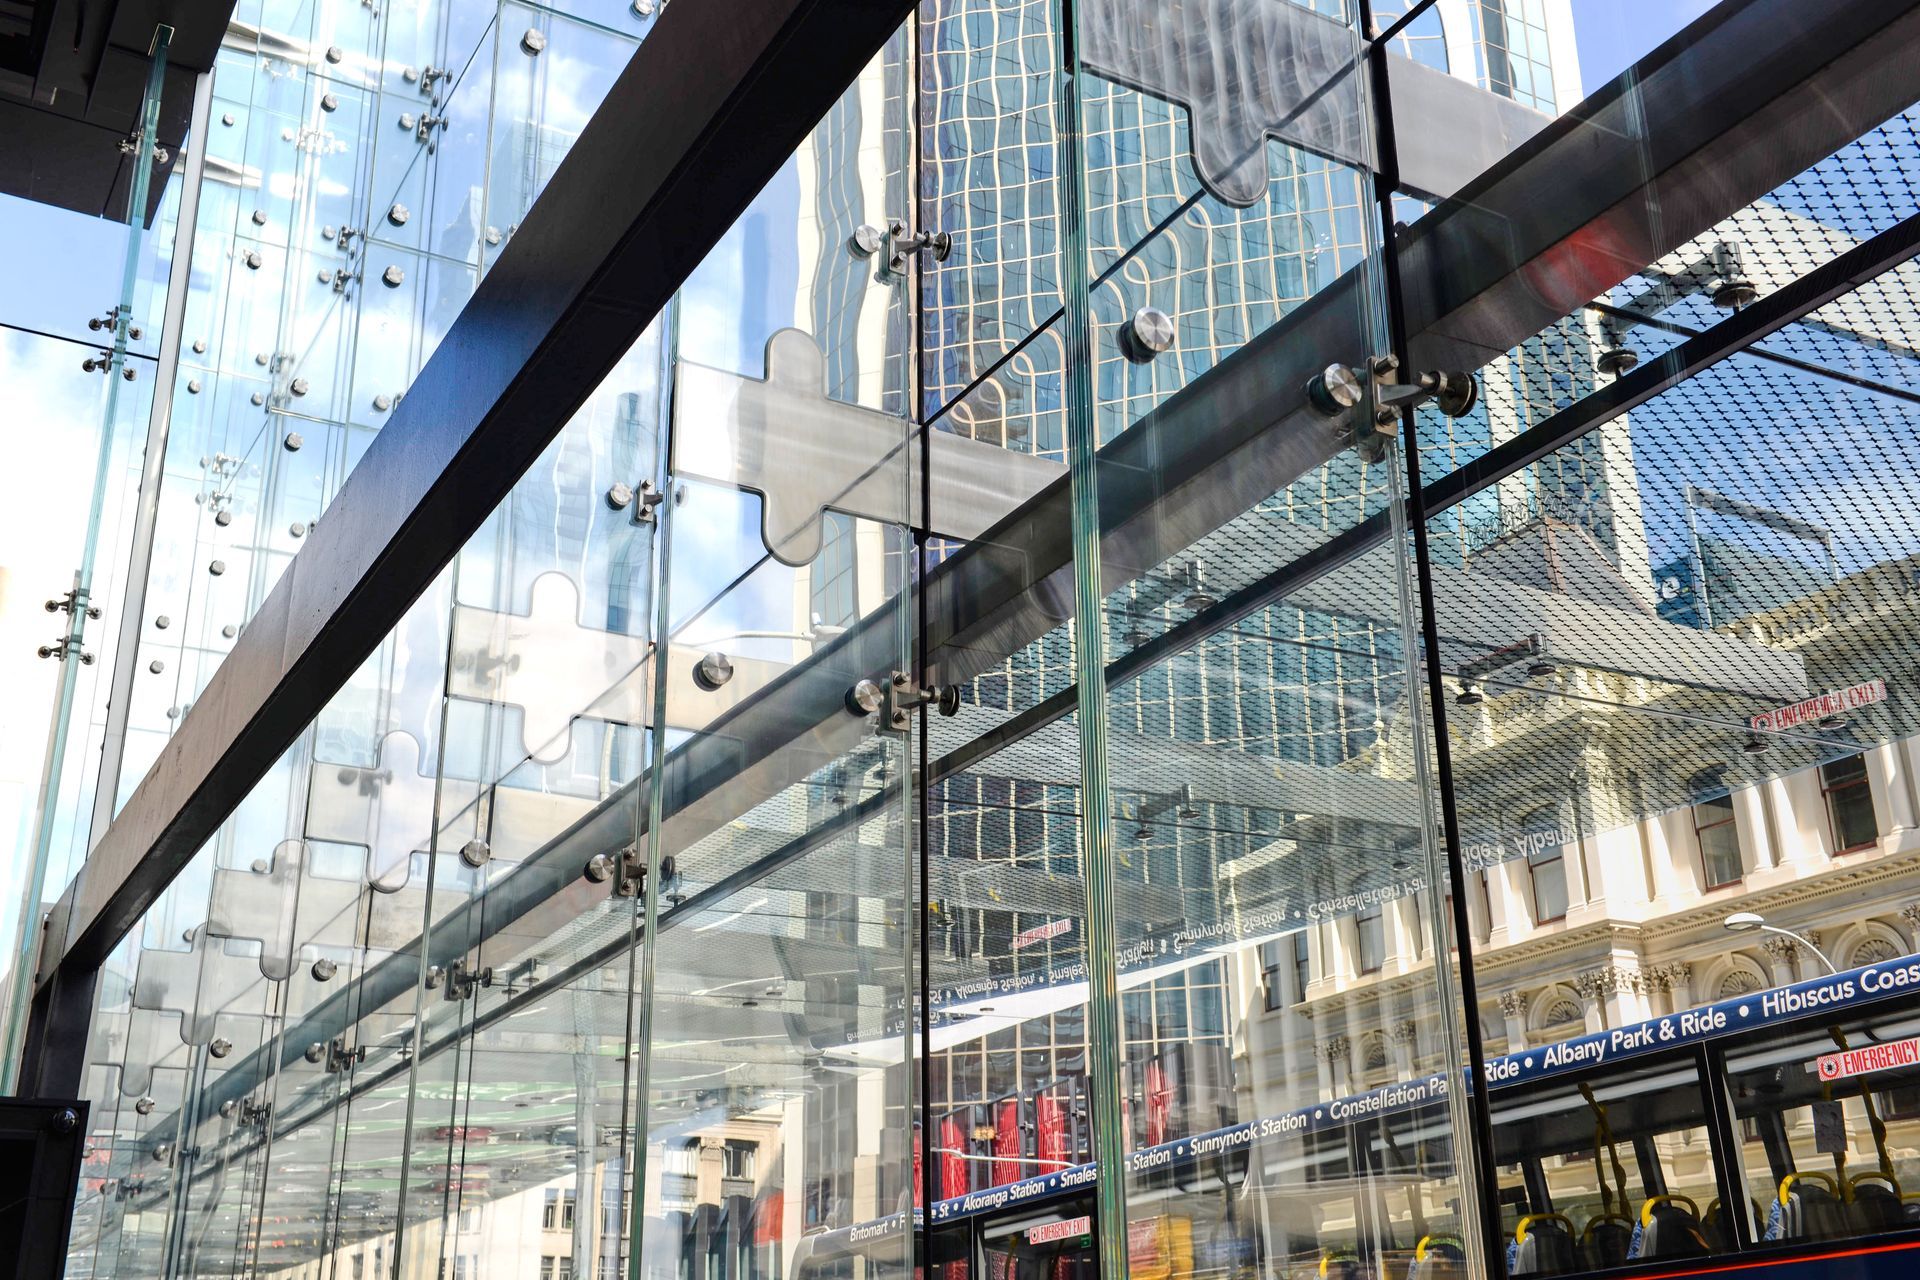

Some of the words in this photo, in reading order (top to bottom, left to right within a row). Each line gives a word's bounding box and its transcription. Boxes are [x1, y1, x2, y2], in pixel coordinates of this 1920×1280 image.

[1843, 1039, 1920, 1075] EMERGENCY
[939, 1202, 950, 1219] St
[962, 1190, 1008, 1213] Akoranga
[1009, 1180, 1045, 1202] Station
[1060, 1166, 1097, 1188] Smales
[1133, 1147, 1171, 1171] Station
[1190, 1122, 1258, 1156] Sunnynook
[1261, 1112, 1307, 1136] Station
[1330, 1085, 1426, 1120] Constellation
[1430, 1076, 1452, 1097] Pa
[1542, 1039, 1606, 1069] Albany
[1611, 1023, 1654, 1053] Park
[1658, 1018, 1677, 1041] &
[1681, 1007, 1727, 1035] Ride
[1762, 981, 1856, 1018] Hibiscus
[1860, 963, 1920, 994] Coas
[1041, 1221, 1073, 1241] EMERGENCY
[1073, 1218, 1086, 1235] EXIT
